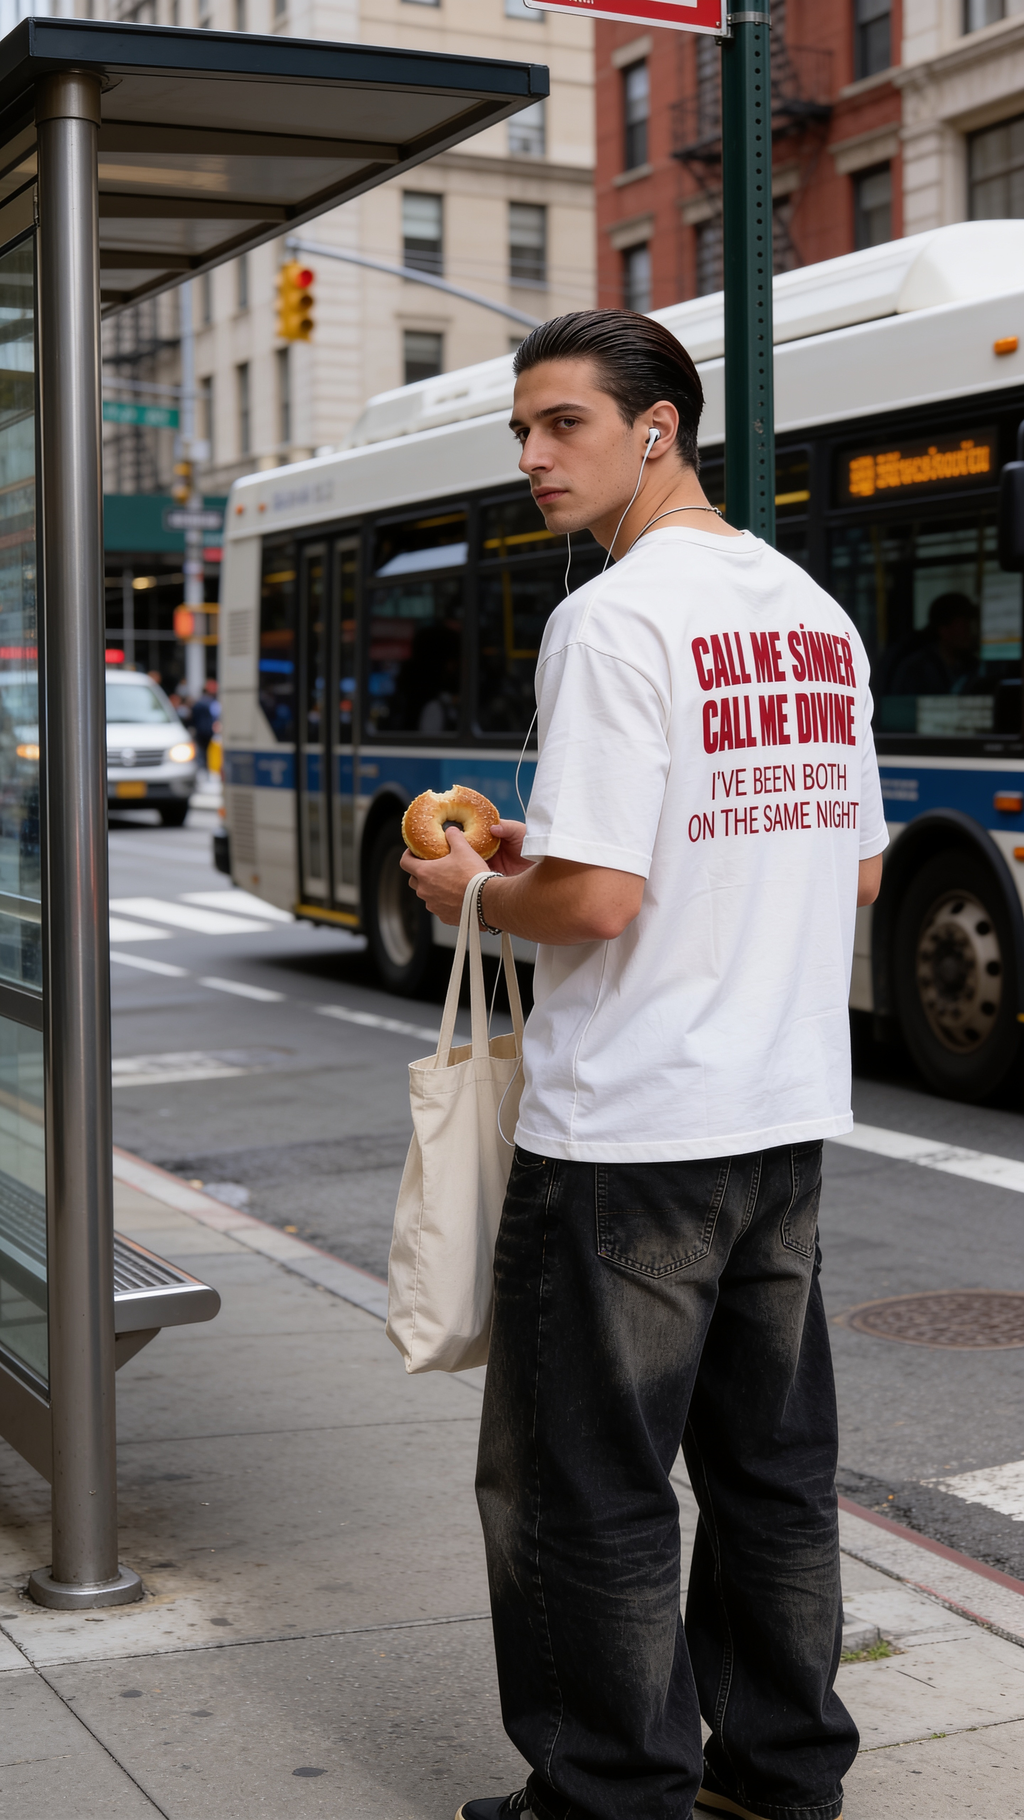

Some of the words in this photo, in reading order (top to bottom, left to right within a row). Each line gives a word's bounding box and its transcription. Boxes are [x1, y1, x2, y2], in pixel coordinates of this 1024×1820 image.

[691, 631, 751, 692] CALL
[749, 631, 787, 684] ME
[702, 694, 758, 755] CALL
[758, 694, 792, 747] ME
[794, 692, 857, 747] DIVINE
[711, 767, 748, 800] I'VE
[753, 764, 796, 795] BEEN
[802, 762, 847, 791] BOTH
[687, 812, 715, 843] ON
[720, 805, 760, 837] THE
[763, 800, 812, 833] SAME
[816, 800, 860, 829] NIGHT
